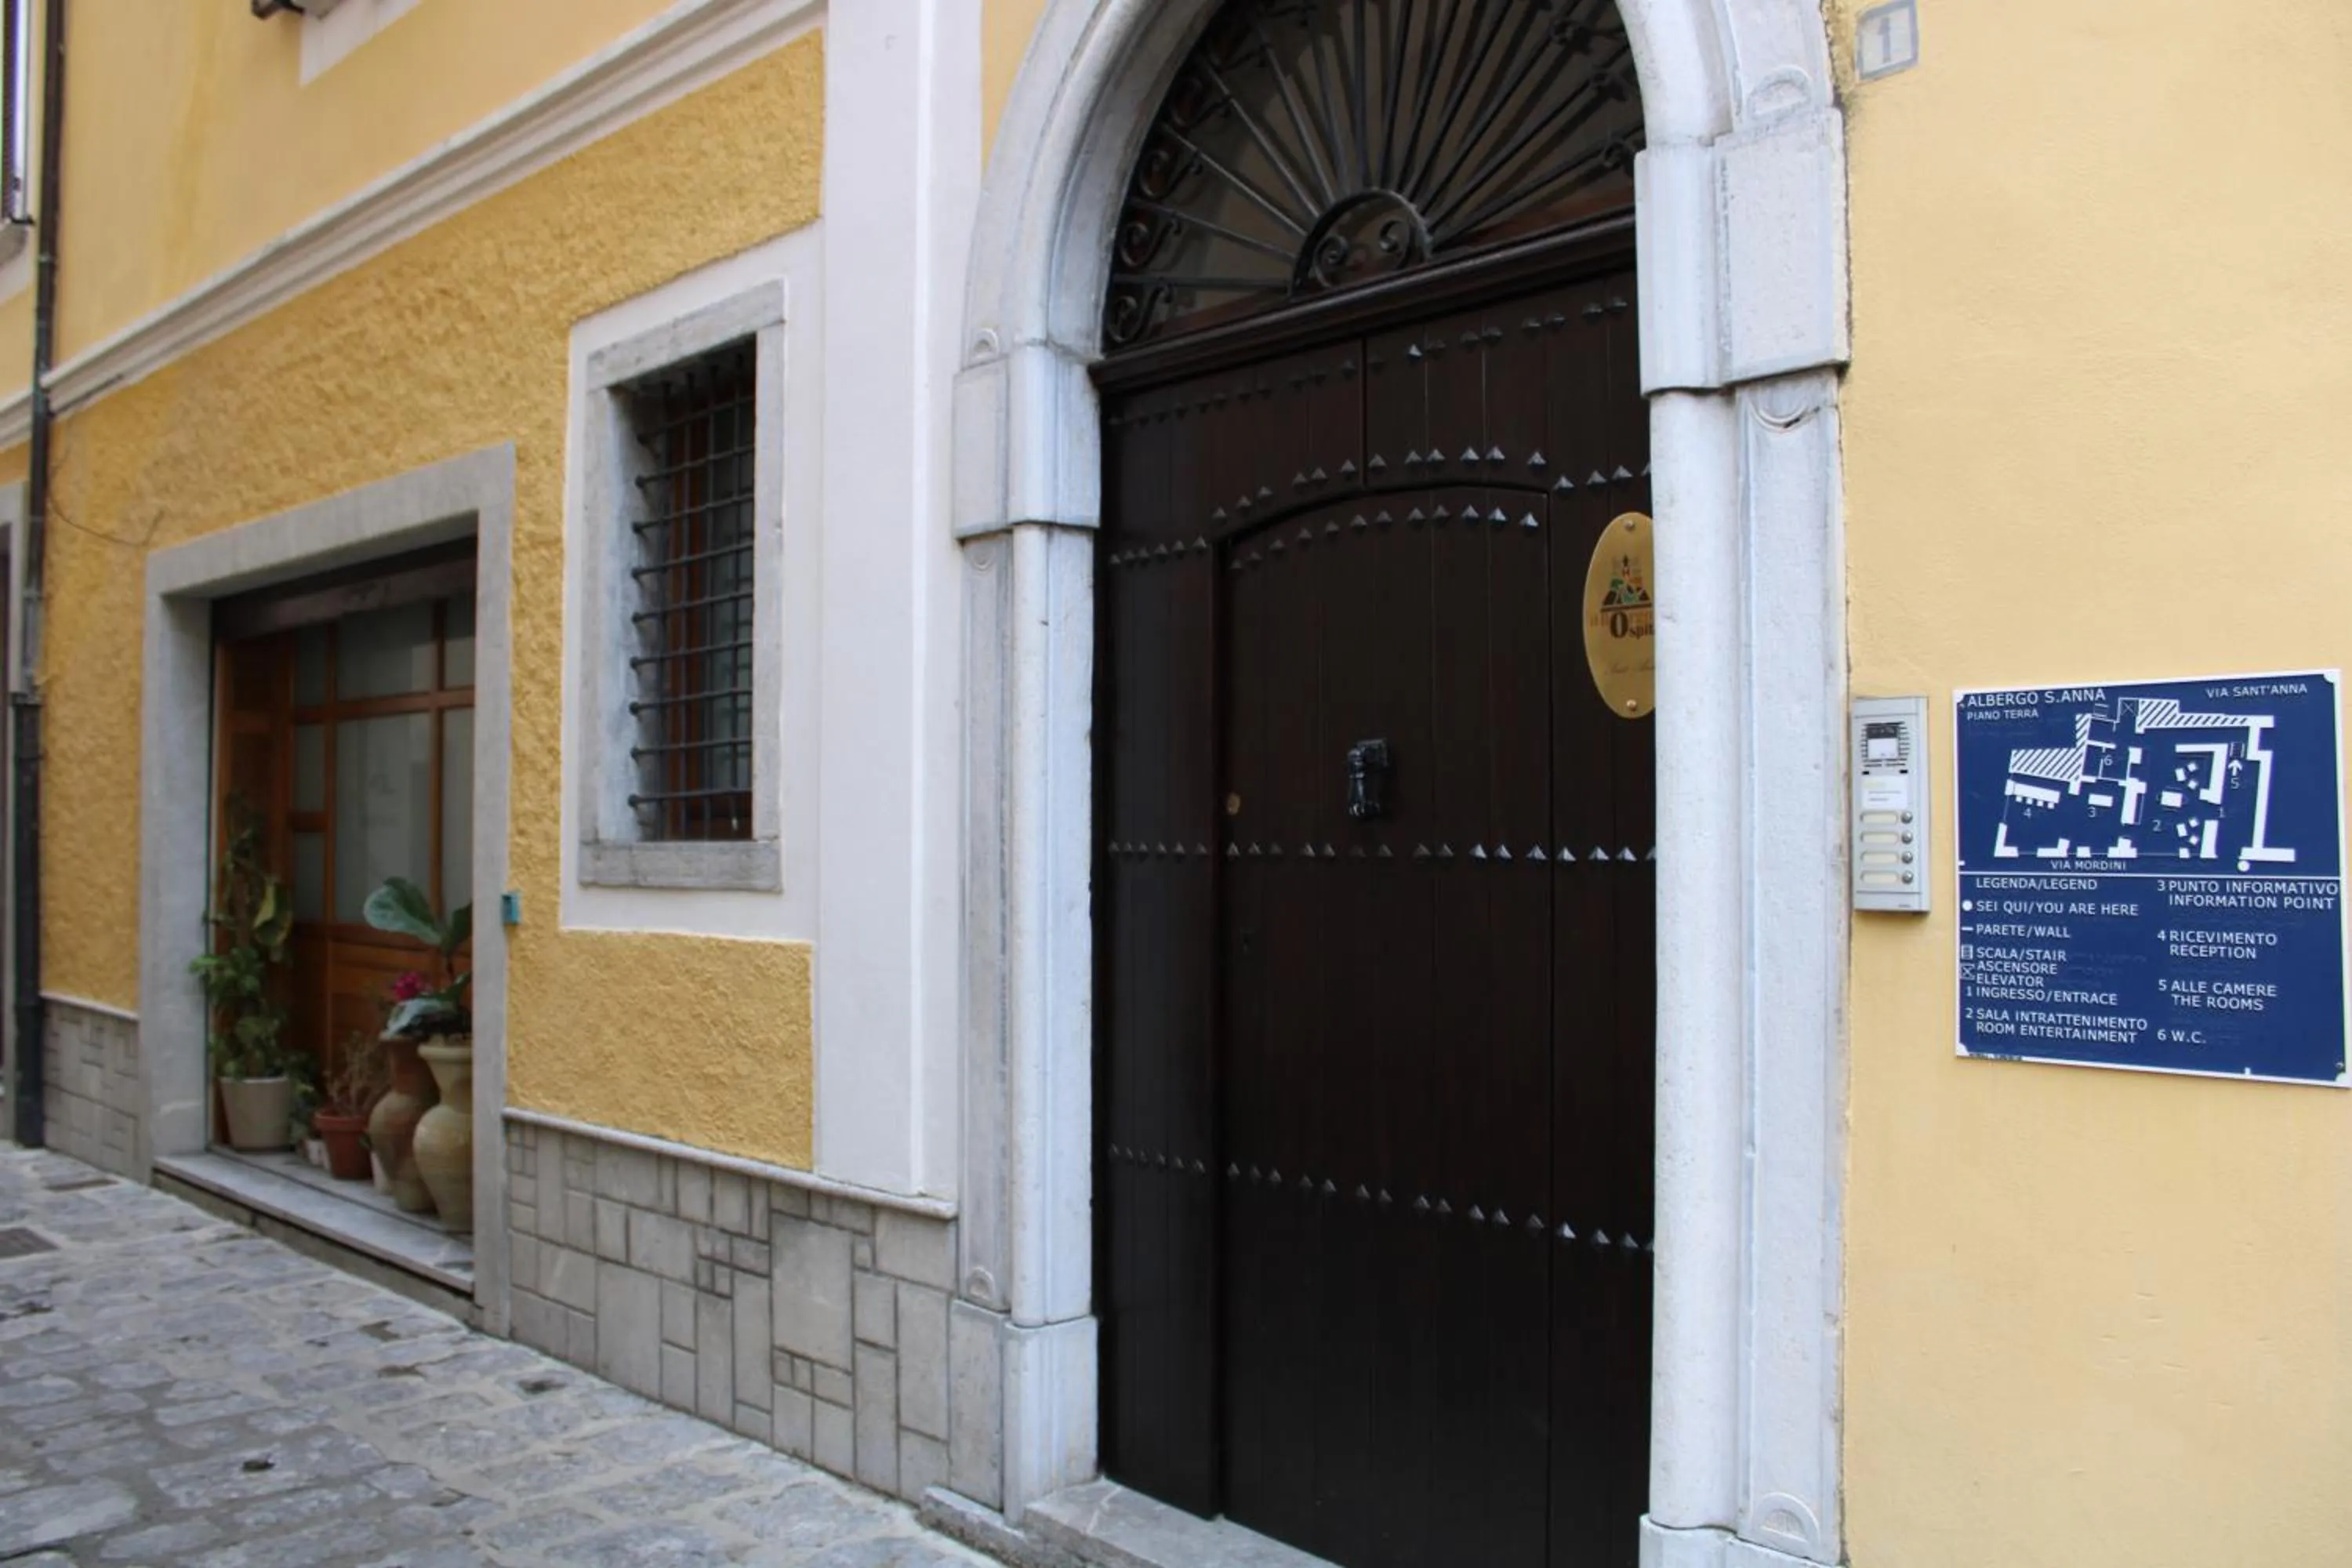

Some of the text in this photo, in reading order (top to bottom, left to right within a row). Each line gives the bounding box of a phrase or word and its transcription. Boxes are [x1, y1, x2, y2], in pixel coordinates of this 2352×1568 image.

[1878, 17, 1891, 63] 1
[1967, 689, 2106, 707] ALBERGO S.ANNA
[2205, 684, 2308, 699] VIA SANT'ANNA
[1966, 709, 2039, 720] PIANO TERRA
[2103, 754, 2113, 766] 6
[2231, 778, 2239, 789] 5
[2023, 808, 2032, 818] 4
[2088, 807, 2096, 818] 3
[2218, 808, 2225, 818] 1
[2152, 820, 2161, 832] 2
[2051, 861, 2126, 871] VIA MORDINI
[1976, 879, 2098, 891] LEGENDA/LEGEND
[2158, 880, 2339, 896] 3 PUNTO INFORMATIVO
[1976, 901, 2139, 916] SEI QUI/YOU ARE HERE
[2169, 894, 2335, 910] INFORMATION POINT
[1976, 924, 2071, 938] PARETE/WALL
[2157, 930, 2278, 946] 4 RICEVIMENTO
[1976, 948, 2067, 962] SCALA/STAIR
[2169, 945, 2256, 959] RECEPTION
[1976, 961, 2058, 975] ASCENSORE
[1976, 974, 2044, 987] ELEVATOR
[2158, 980, 2278, 996] 5 ALLE CAMERE
[1966, 986, 2118, 1006] 1 INGRESSO/ENTRACE
[2172, 994, 2263, 1011] THE ROOMS
[1965, 1008, 2147, 1031] 2 SALA INTRATTENIMENTO
[1976, 1022, 2137, 1044] ROOM ENTERTAINMENT
[2157, 1029, 2206, 1044] 6 W.C.
